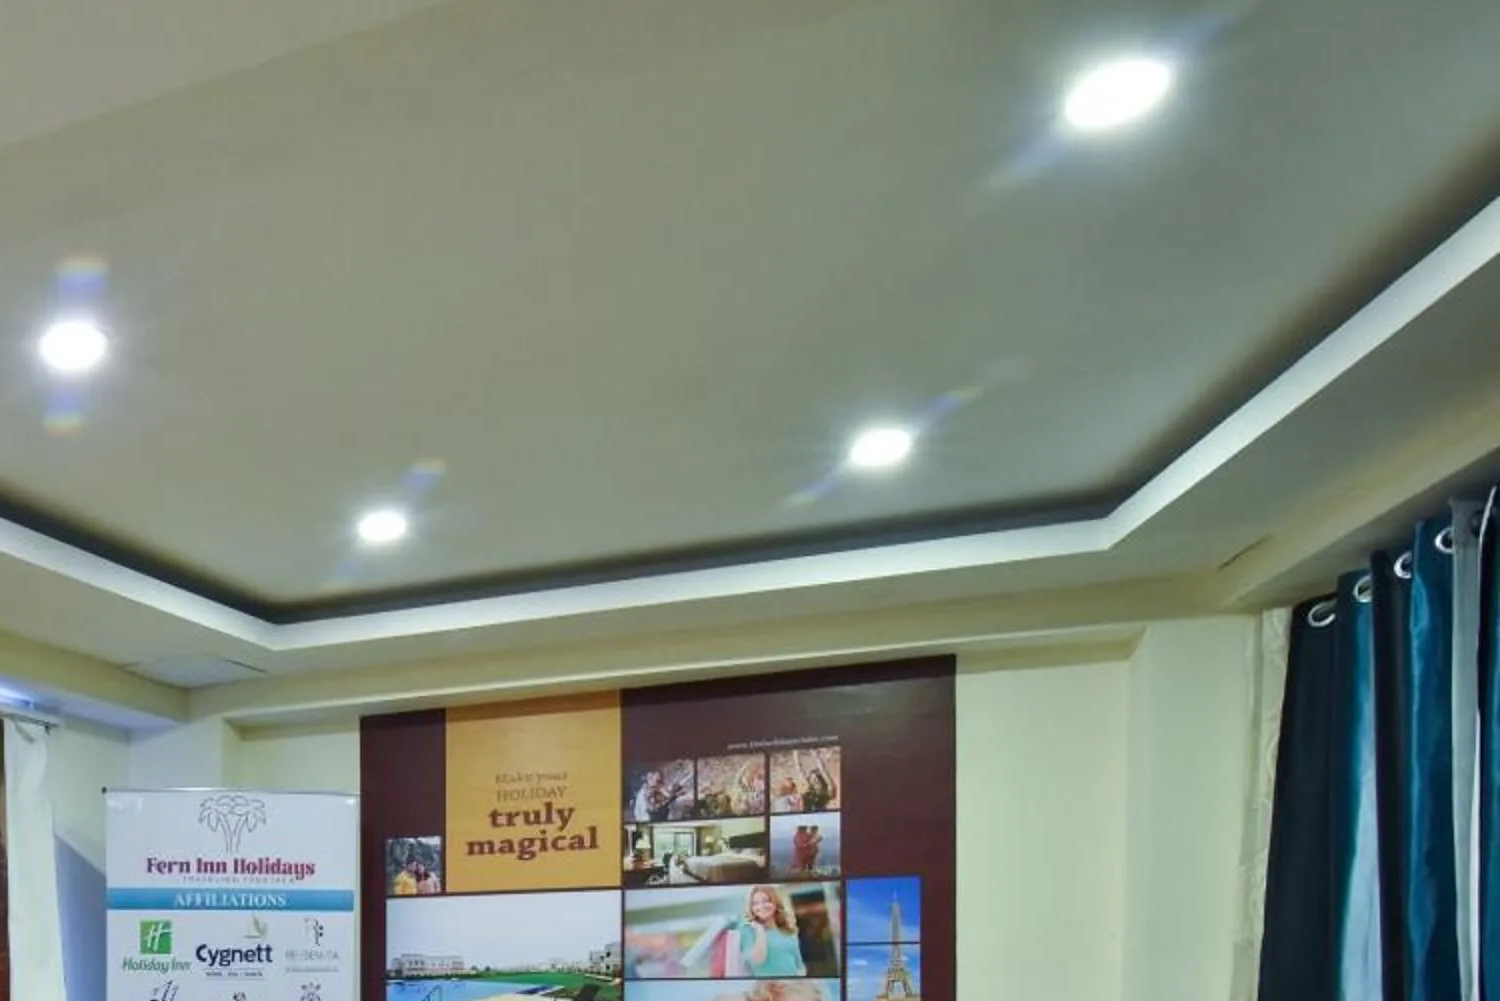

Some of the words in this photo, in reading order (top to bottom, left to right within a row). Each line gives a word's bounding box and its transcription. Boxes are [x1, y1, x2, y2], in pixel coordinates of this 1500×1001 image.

[496, 785, 567, 802] HOLIDAY
[488, 801, 575, 832] truly
[466, 825, 599, 861] magical
[146, 857, 191, 874] Fern
[196, 857, 227, 874] Inn
[233, 857, 316, 881] Holidays
[175, 893, 288, 908] AFFILIATIONS
[122, 957, 169, 974] Holiday
[172, 957, 192, 971] Inn
[195, 943, 273, 967] Cygnett
